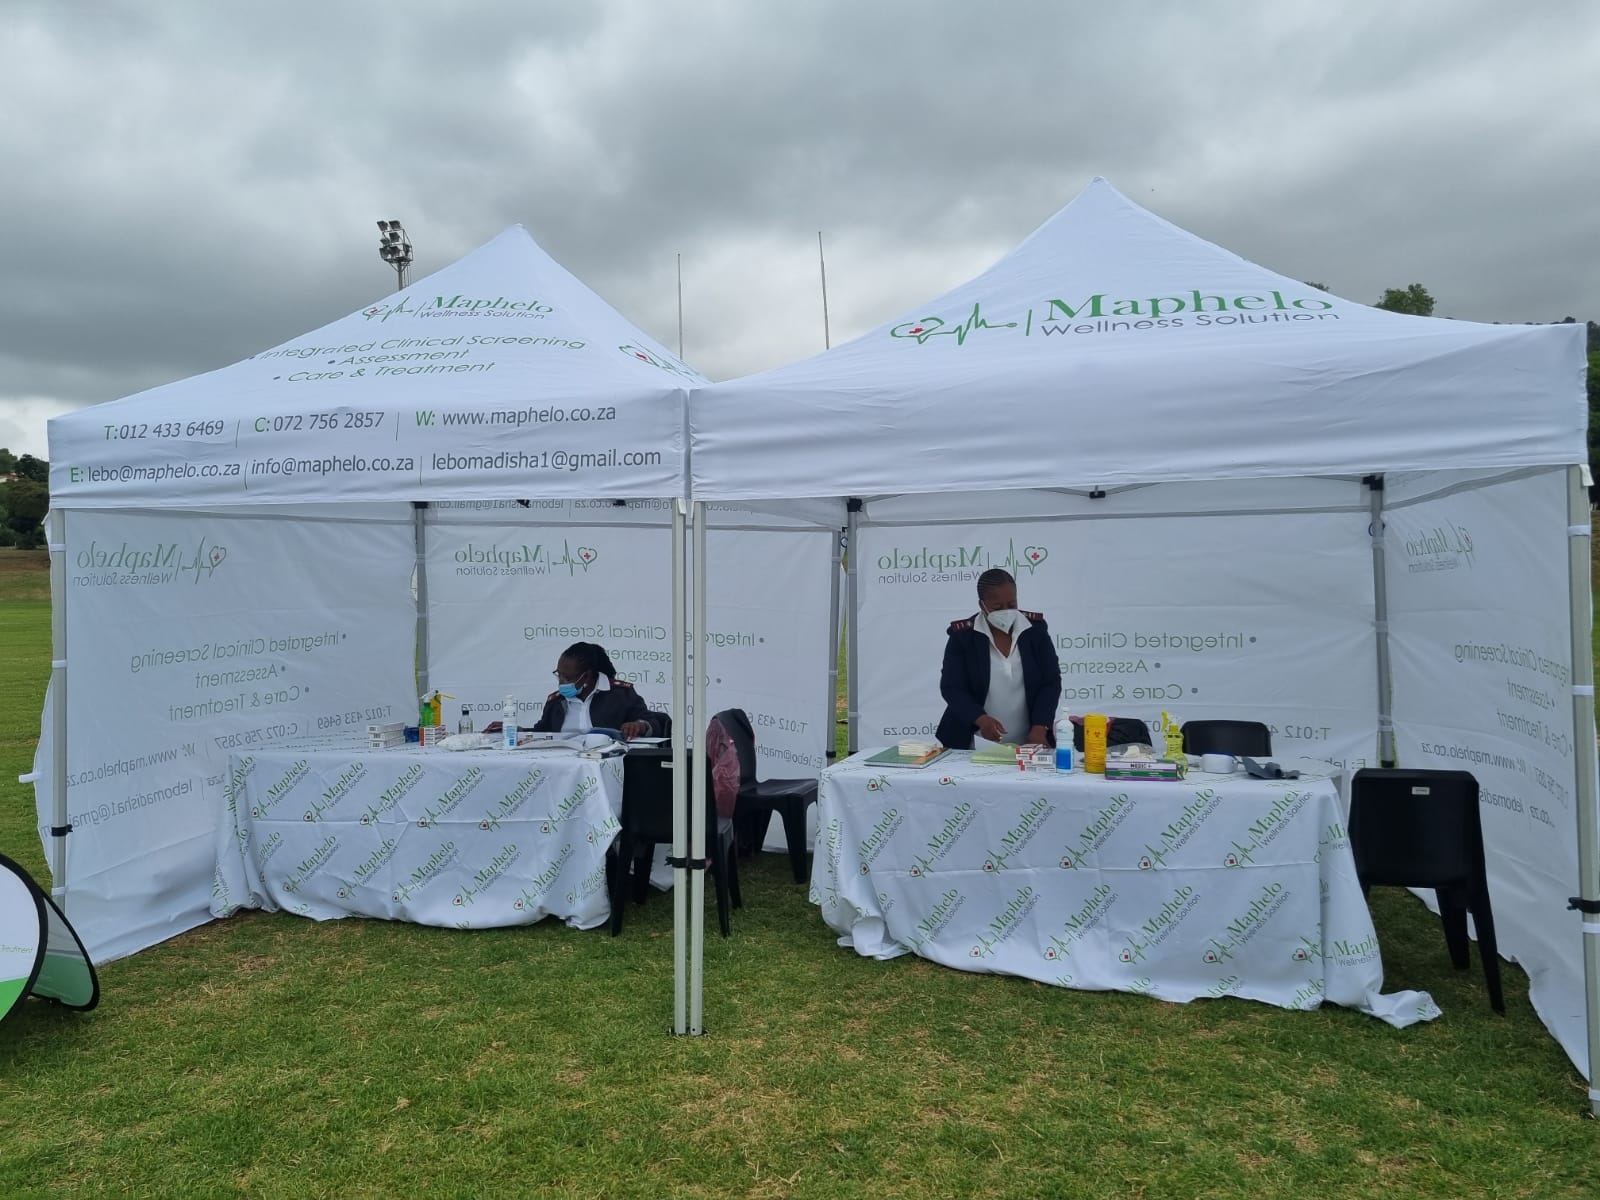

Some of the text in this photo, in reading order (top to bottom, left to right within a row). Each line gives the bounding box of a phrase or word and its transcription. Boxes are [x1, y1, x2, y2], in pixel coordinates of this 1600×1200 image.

[419, 308, 546, 320] Wellness Solution
[426, 295, 553, 313] Maphelo
[1041, 310, 1340, 338] Wellness Solution
[1043, 289, 1334, 322] Maphelo
[259, 335, 586, 361] Integrated Clinical Screening
[338, 349, 470, 366] Assessment
[288, 361, 496, 382] Care & Treatment
[152, 422, 182, 438] 433
[186, 420, 224, 436] 6469
[308, 413, 338, 430] 756
[344, 412, 385, 429] 2857
[416, 406, 616, 428] W: www.maphelo.co.za
[88, 460, 240, 483] lebo@maphelo.co.za
[251, 455, 414, 476] info@maphelo.co.za
[432, 449, 662, 471] lebomadisha1@gmail.com
[267, 759, 308, 797] Maphelo
[322, 761, 364, 800] Maphelo
[380, 763, 422, 803] Maphelo
[438, 766, 481, 806] Maphelo
[499, 768, 542, 808] Maphelo
[928, 802, 972, 850] Maphelo
[958, 809, 979, 834] Solution
[1001, 798, 1048, 846] Maphelo
[1012, 804, 1056, 855] Wellness Solution
[1080, 792, 1129, 842] Maphelo
[1092, 800, 1137, 851] Wellness Solution
[1160, 788, 1214, 840] Maphelo
[1174, 795, 1223, 850] Wellness Solution
[1261, 819, 1288, 846] Wellness
[296, 834, 337, 872] Maphelo
[354, 838, 395, 878] Maphelo
[411, 840, 455, 880] Maphelo
[474, 844, 517, 884] Maphelo
[917, 888, 958, 932] Maphelo
[990, 886, 1033, 933] Maphelo
[1020, 894, 1041, 919] Solution
[1064, 884, 1111, 931] Maphelo
[1076, 892, 1119, 940] Wellness Solution
[1142, 886, 1193, 934] Maphelo
[1154, 894, 1201, 947] Wellness Solution
[1226, 882, 1282, 936] Maphelo
[1240, 890, 1291, 945] Wellness Solution
[1338, 956, 1370, 968] Wellness
